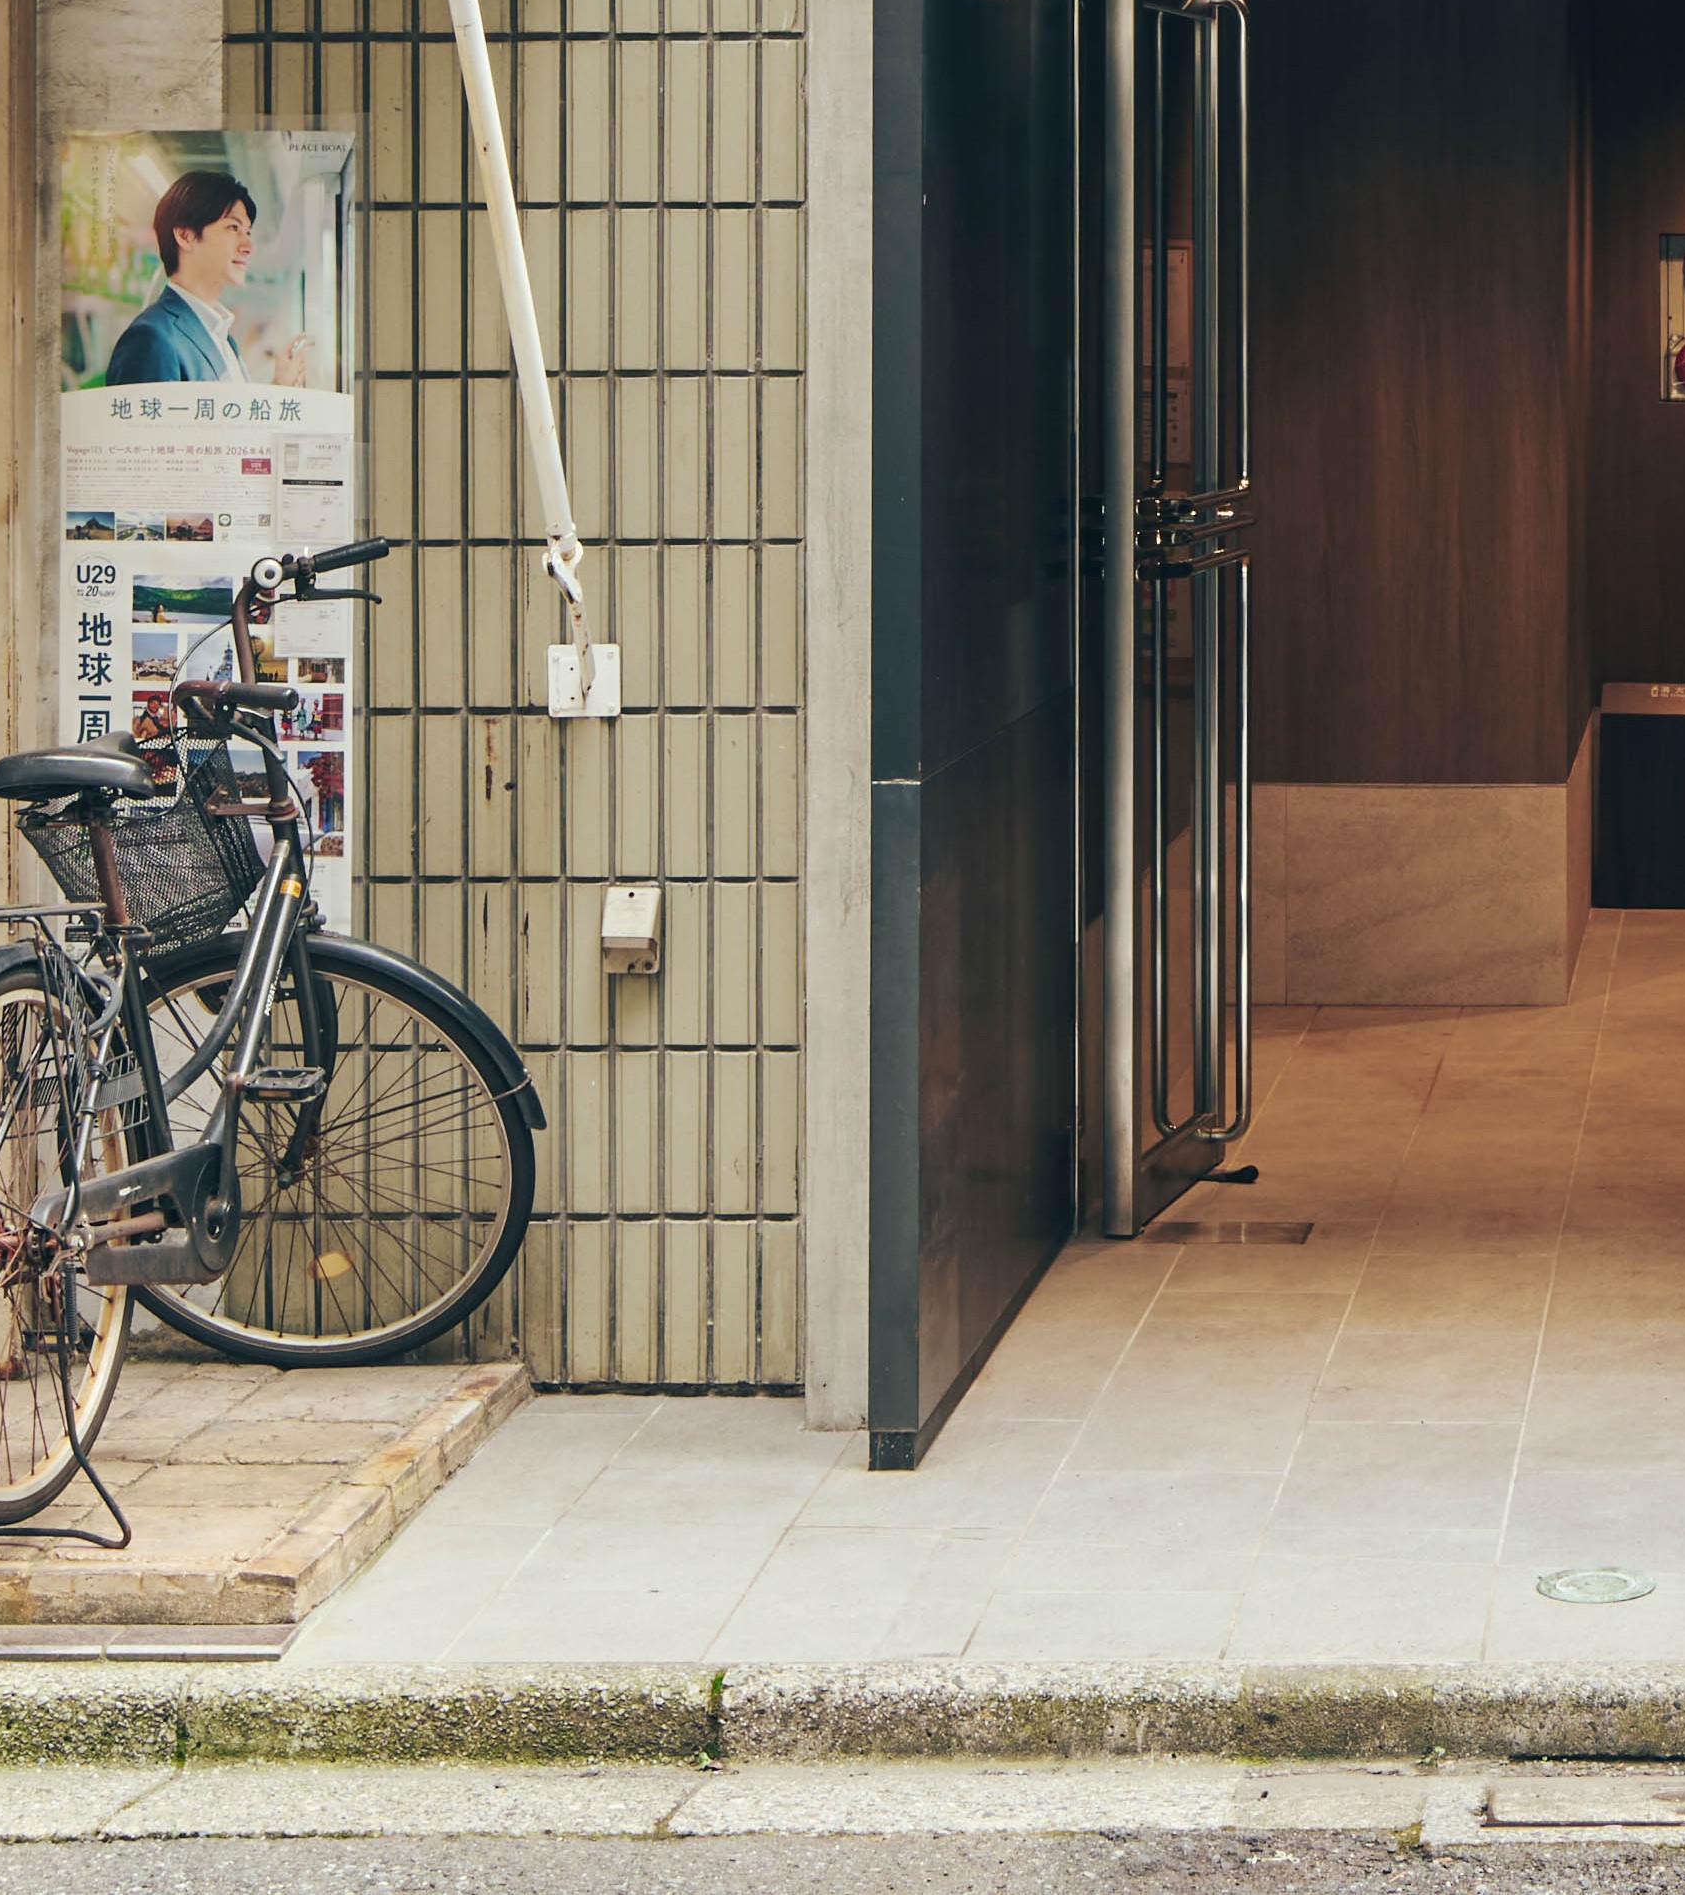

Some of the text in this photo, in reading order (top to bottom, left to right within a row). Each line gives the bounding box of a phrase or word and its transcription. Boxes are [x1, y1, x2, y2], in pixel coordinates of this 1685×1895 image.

[289, 145, 347, 153] PEACE BOAT
[111, 399, 303, 421] 地球一周の船旅
[76, 565, 117, 584] U29
